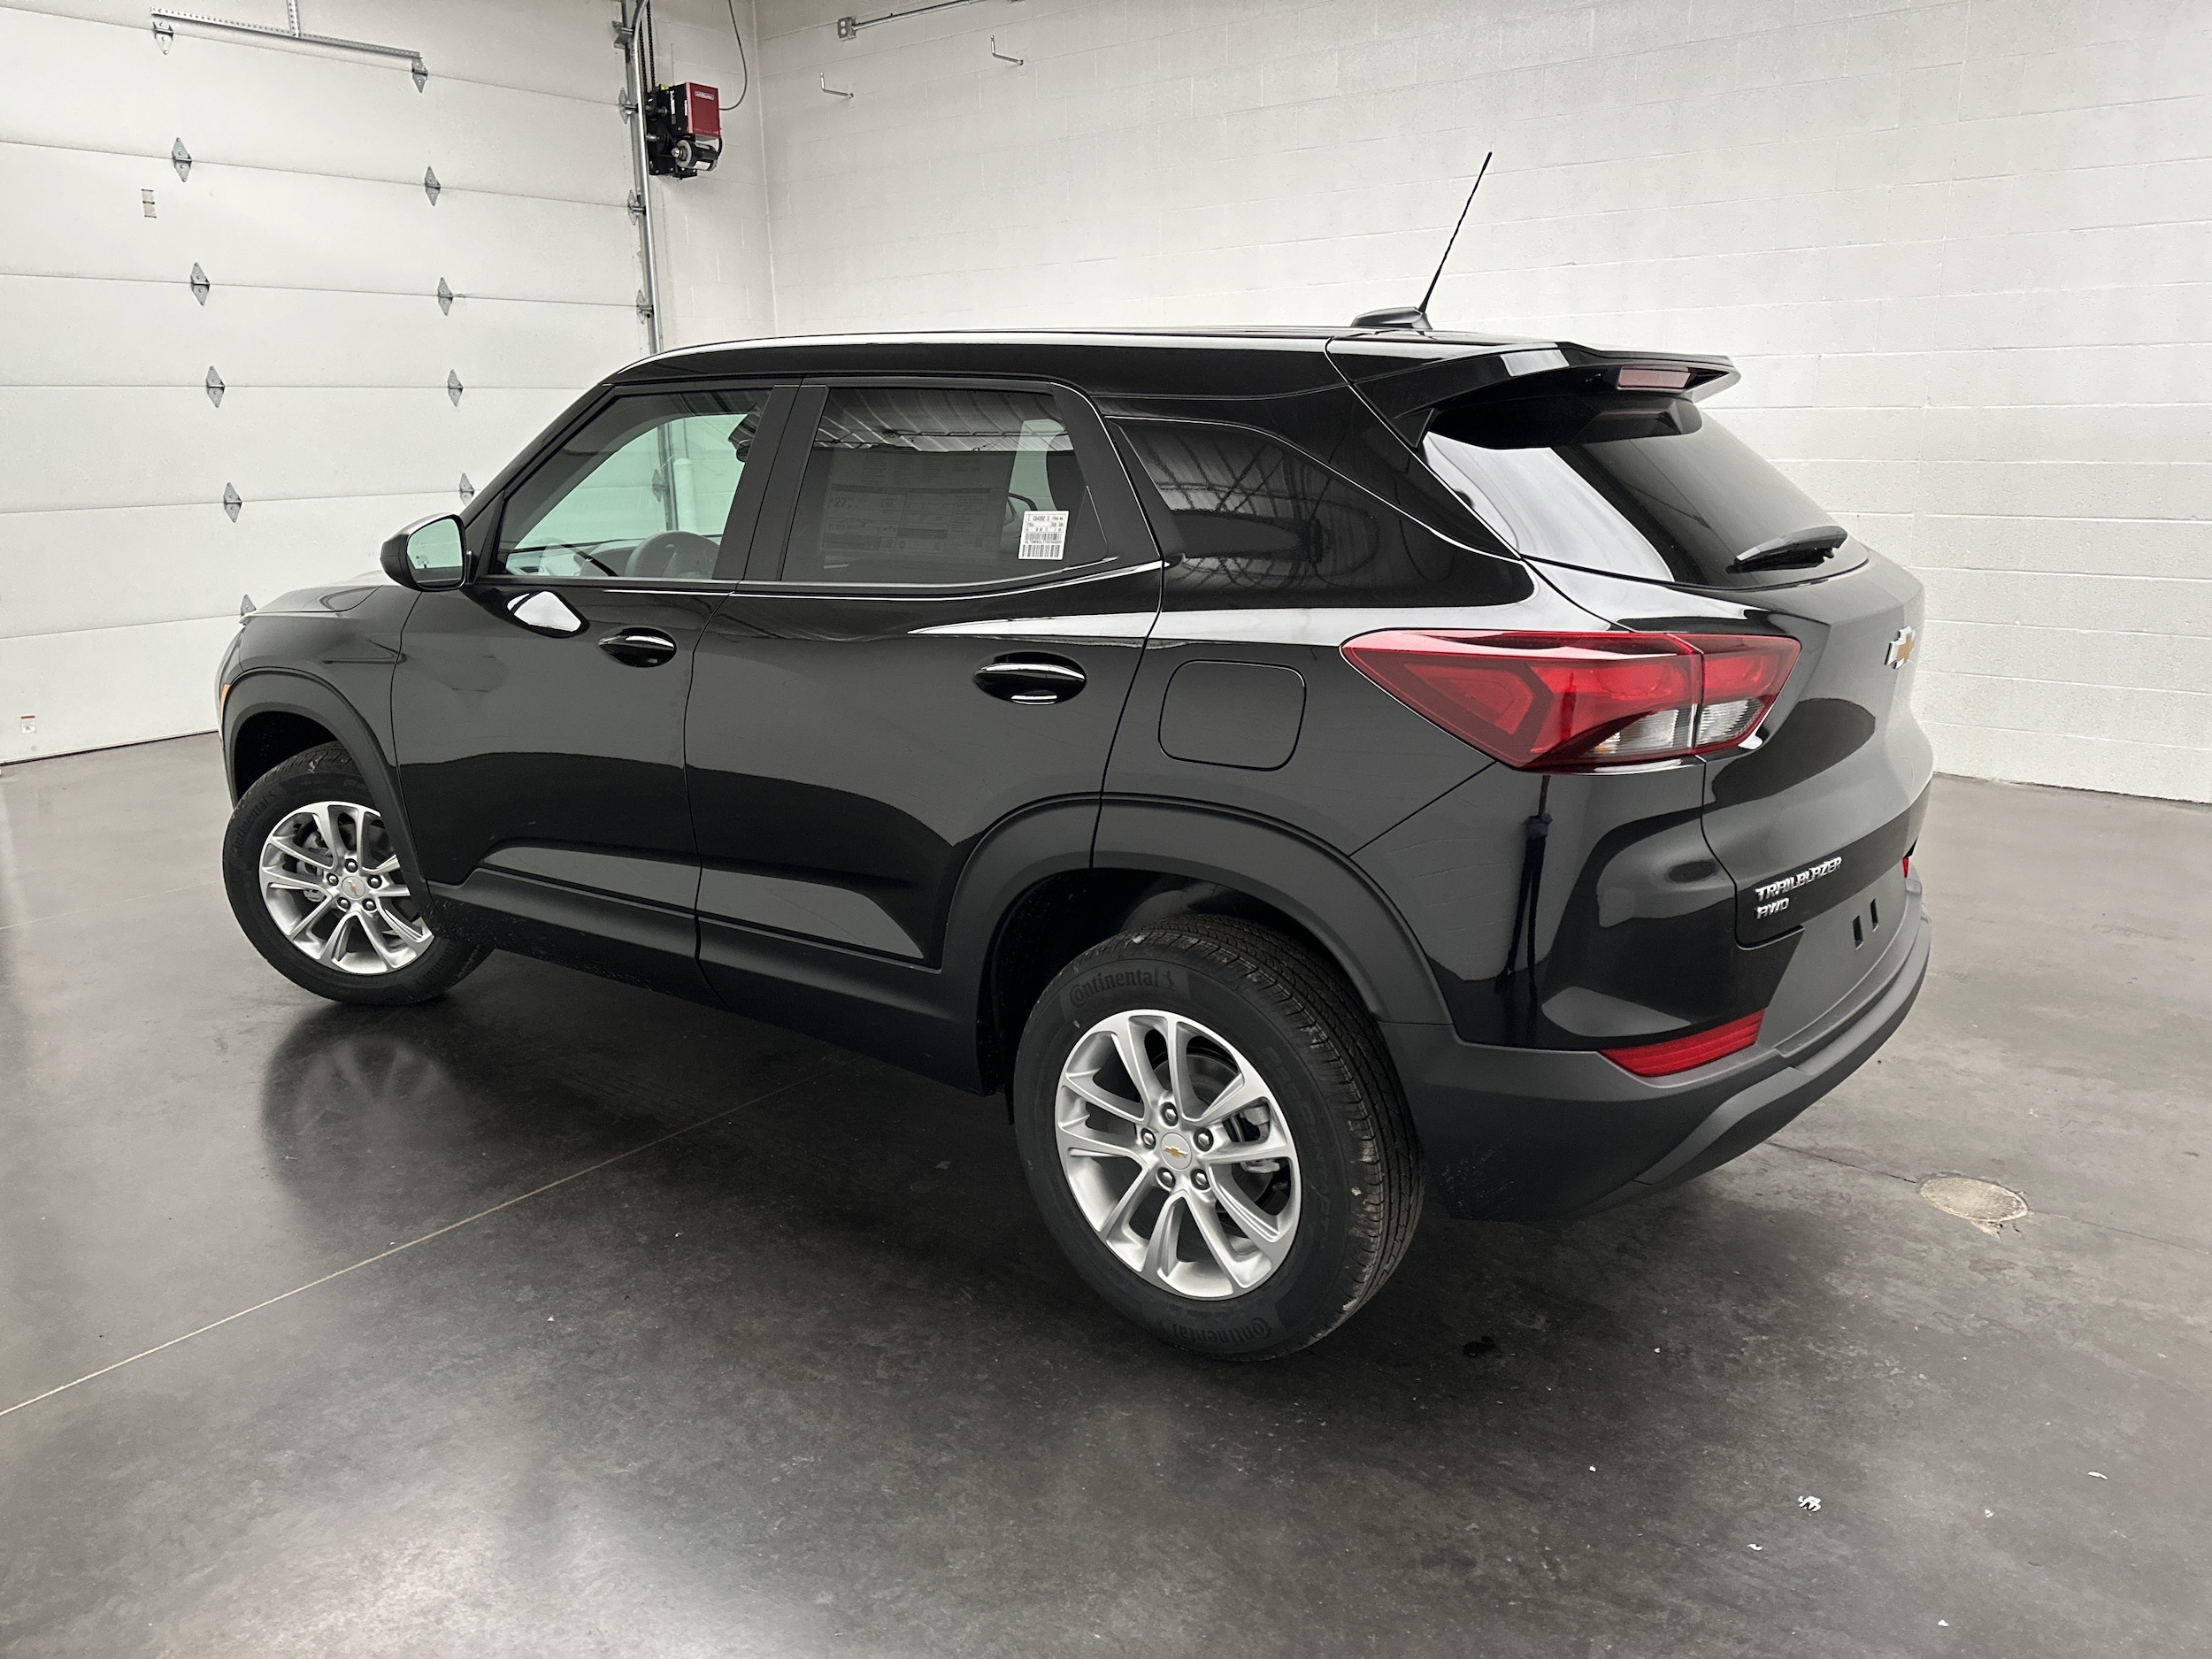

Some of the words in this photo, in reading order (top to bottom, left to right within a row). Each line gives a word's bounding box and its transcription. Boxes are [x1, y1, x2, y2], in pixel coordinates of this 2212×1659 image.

[1755, 856, 1842, 902] TRAILBLAZER
[1755, 897, 1790, 920] AWD
[1069, 968, 1158, 1008] Continental
[1172, 1317, 1271, 1343] Continental
